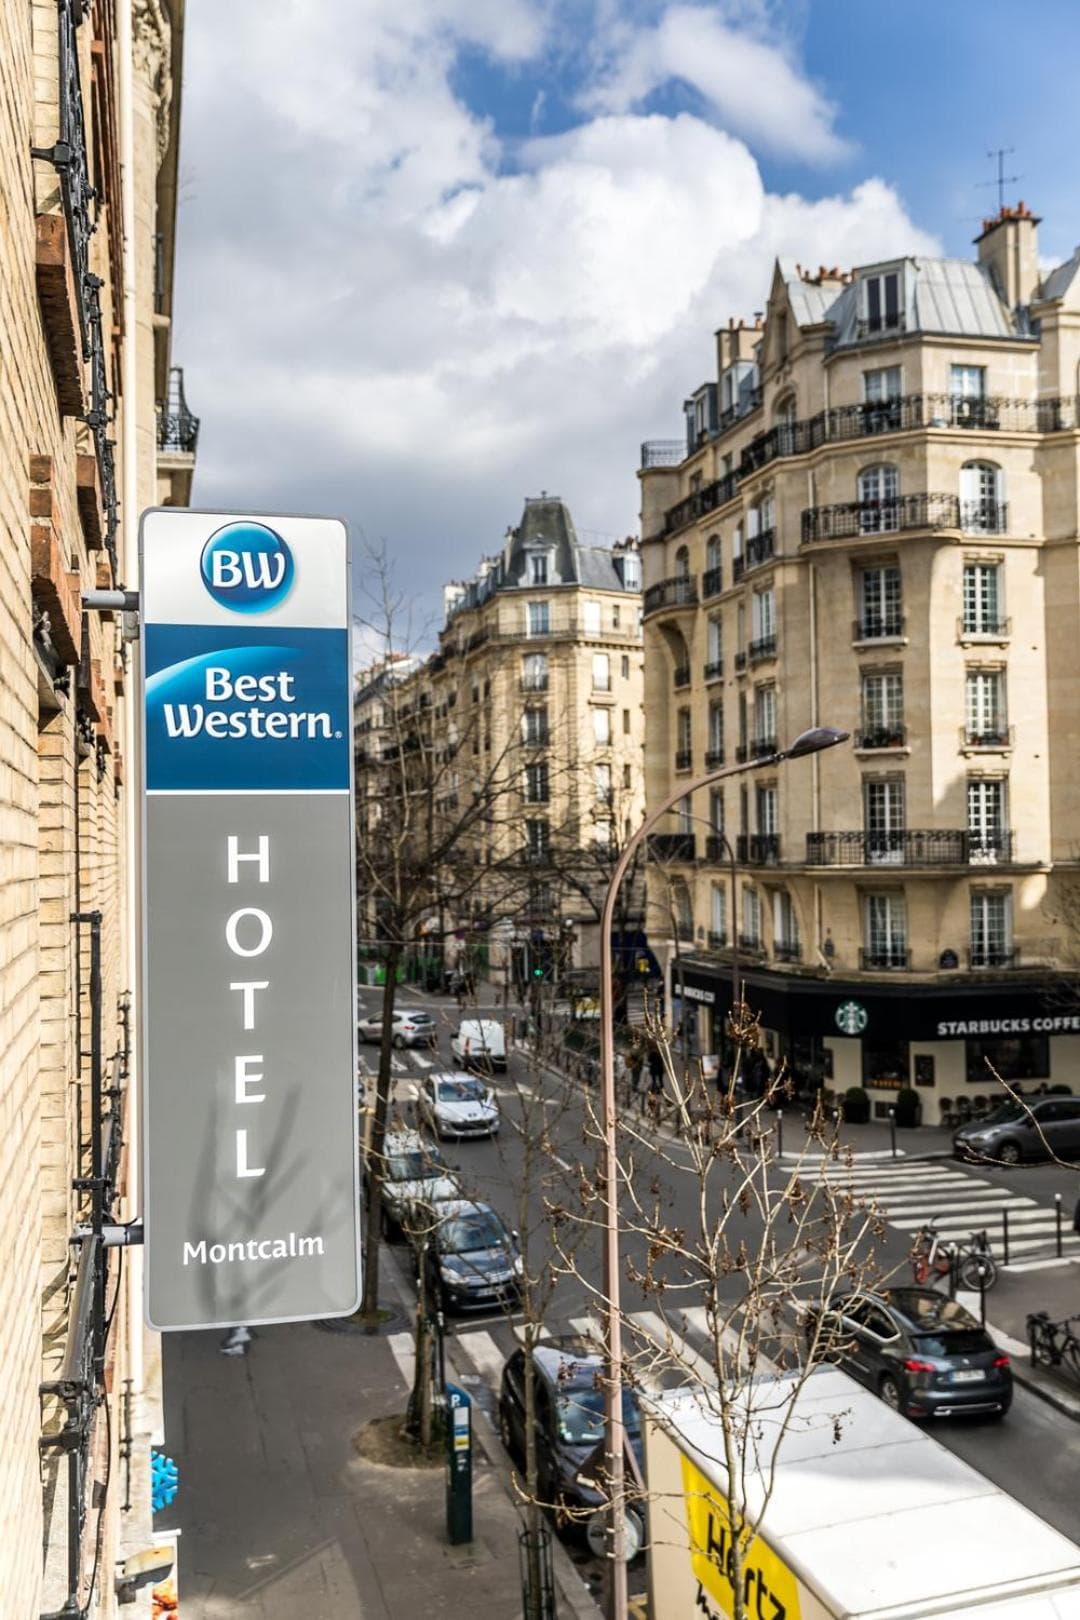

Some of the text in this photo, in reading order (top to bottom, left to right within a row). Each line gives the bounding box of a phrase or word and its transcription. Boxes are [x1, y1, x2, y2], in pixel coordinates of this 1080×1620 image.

[212, 551, 285, 589] BW
[205, 667, 295, 703] Best
[226, 835, 273, 1179] HOTEL
[937, 1018, 1031, 1036] STARBUCKS
[183, 1232, 325, 1265] Montcalm
